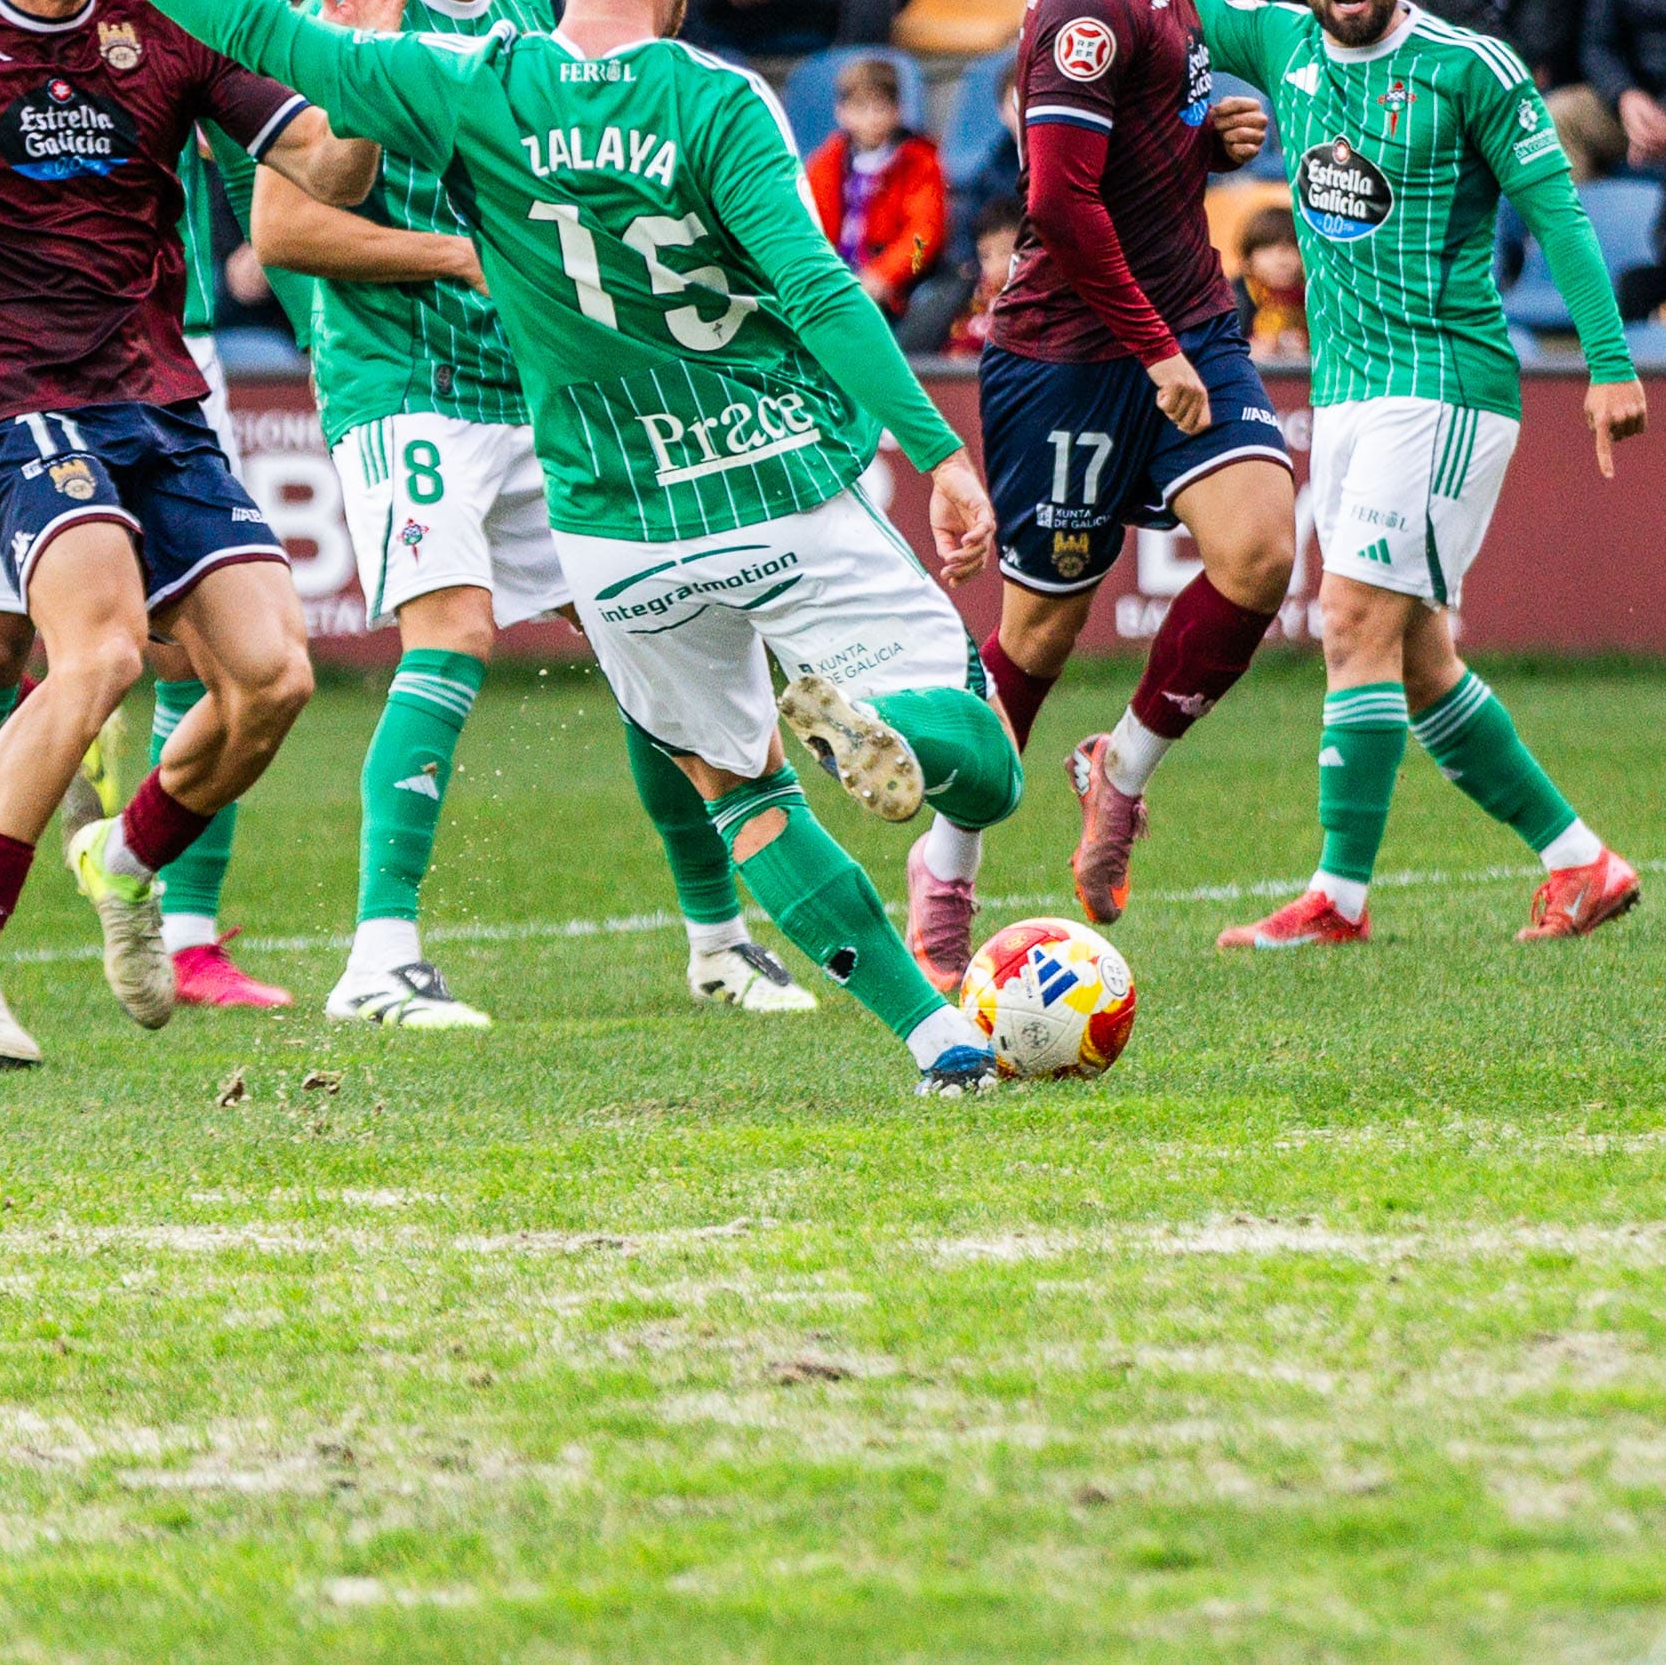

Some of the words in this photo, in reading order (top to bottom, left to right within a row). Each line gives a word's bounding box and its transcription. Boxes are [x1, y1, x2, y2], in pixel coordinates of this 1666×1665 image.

[19, 105, 114, 132] Estrella
[25, 130, 111, 157] Galicia
[520, 126, 676, 187] ZALAYA
[1308, 159, 1373, 196] Estrella
[1308, 183, 1366, 219] Galicia
[528, 200, 759, 352] 15
[15, 412, 88, 461] 11
[635, 393, 814, 474] Prace
[403, 440, 444, 505] 8
[1047, 430, 1113, 504] 17
[1054, 519, 1067, 528] DE
[1055, 508, 1092, 518] XUNTA
[599, 551, 798, 623] integralmotion
[816, 643, 868, 673] XUNTA
[845, 642, 904, 679] GALICIA
